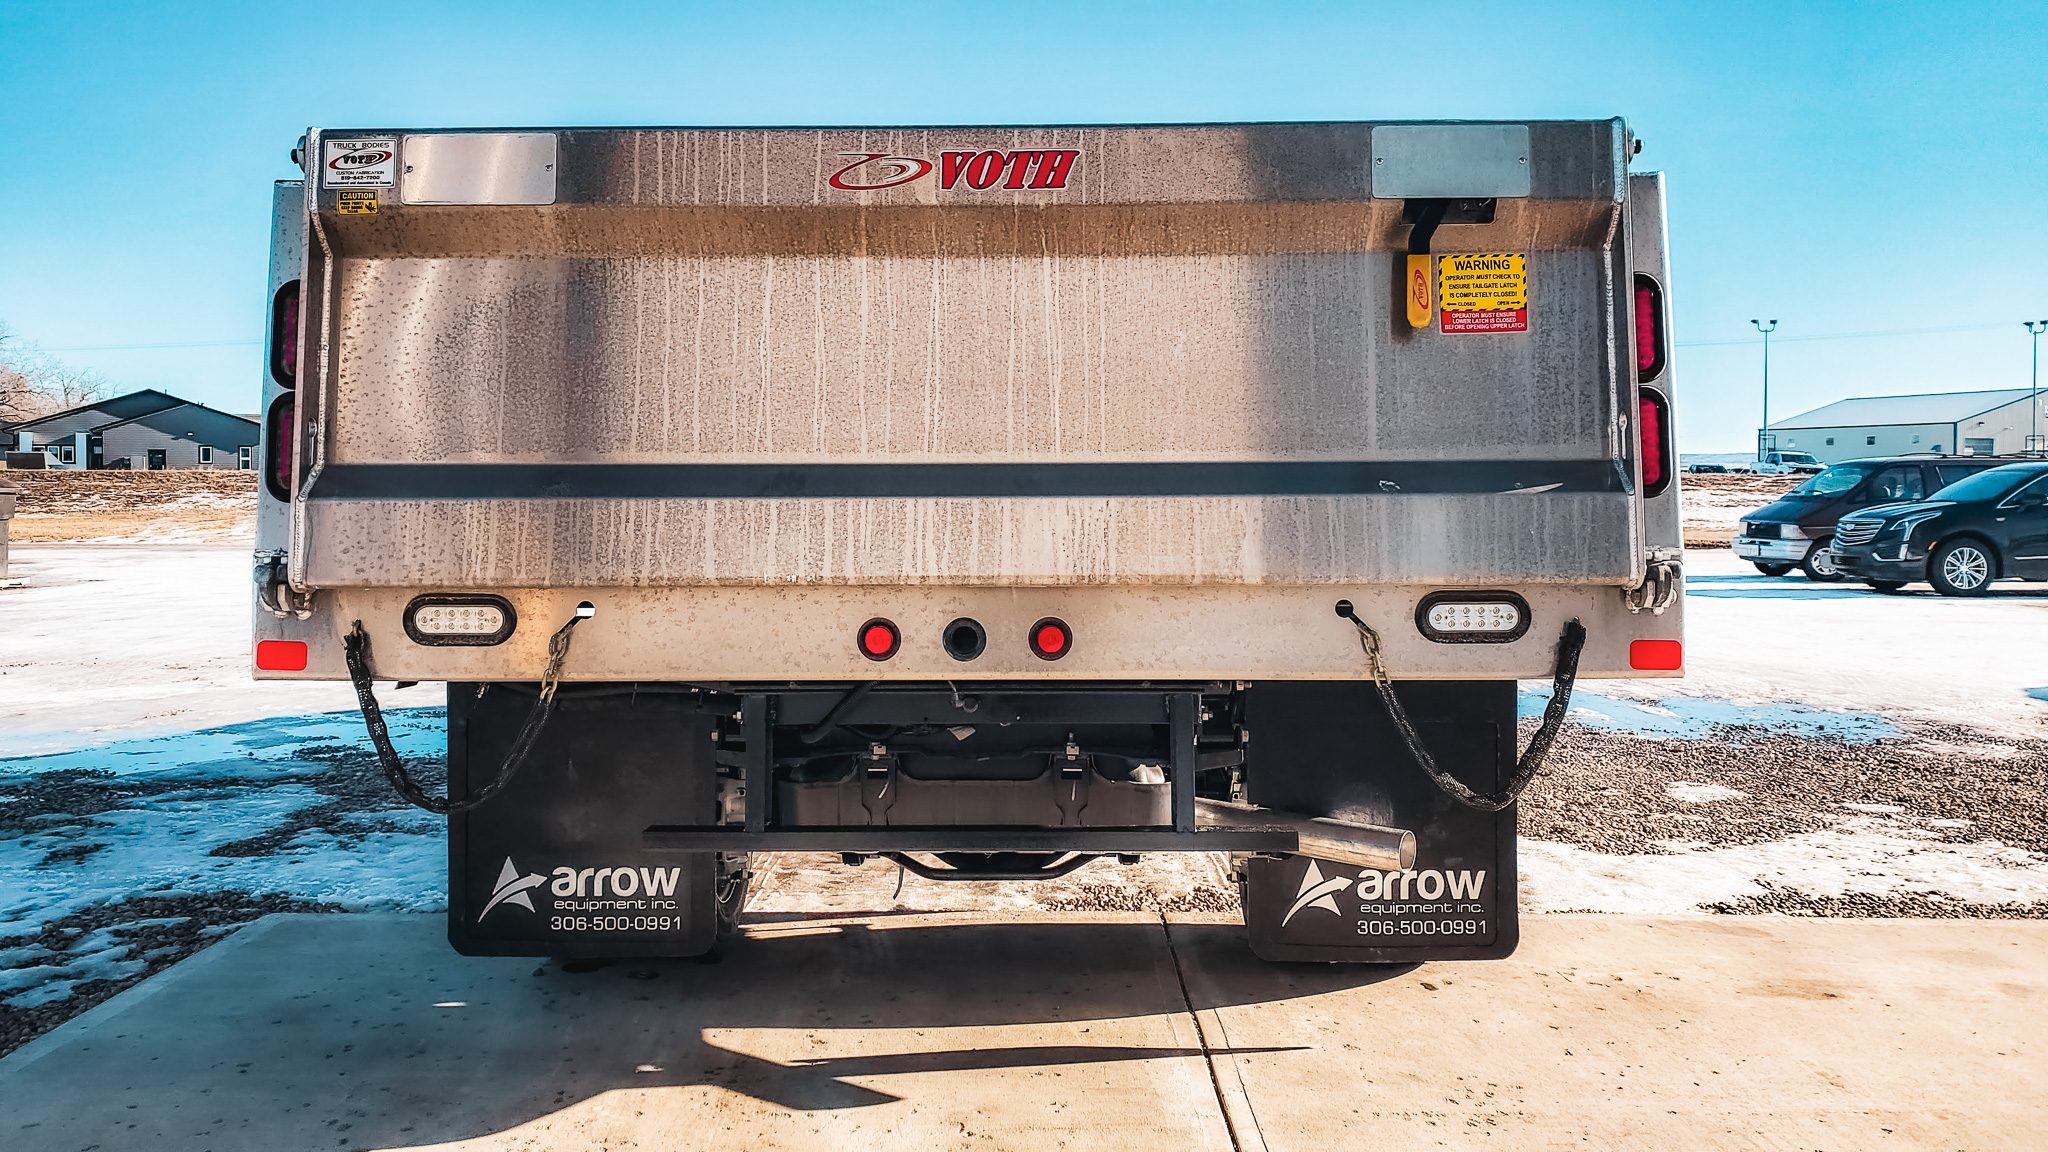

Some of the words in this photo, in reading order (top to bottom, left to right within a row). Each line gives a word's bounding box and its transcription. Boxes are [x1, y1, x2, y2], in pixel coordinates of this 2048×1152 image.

[941, 150, 1080, 190] VOTH
[1454, 260, 1510, 270] WARNING
[551, 866, 681, 897] arrow
[1357, 869, 1486, 900] arrow
[554, 898, 646, 912] equipment
[651, 898, 679, 910] inc.
[1360, 902, 1453, 916] equipment
[1457, 902, 1484, 913] inc.
[551, 916, 681, 931] 306-500-0991
[1357, 920, 1486, 935] 306-500-0991
